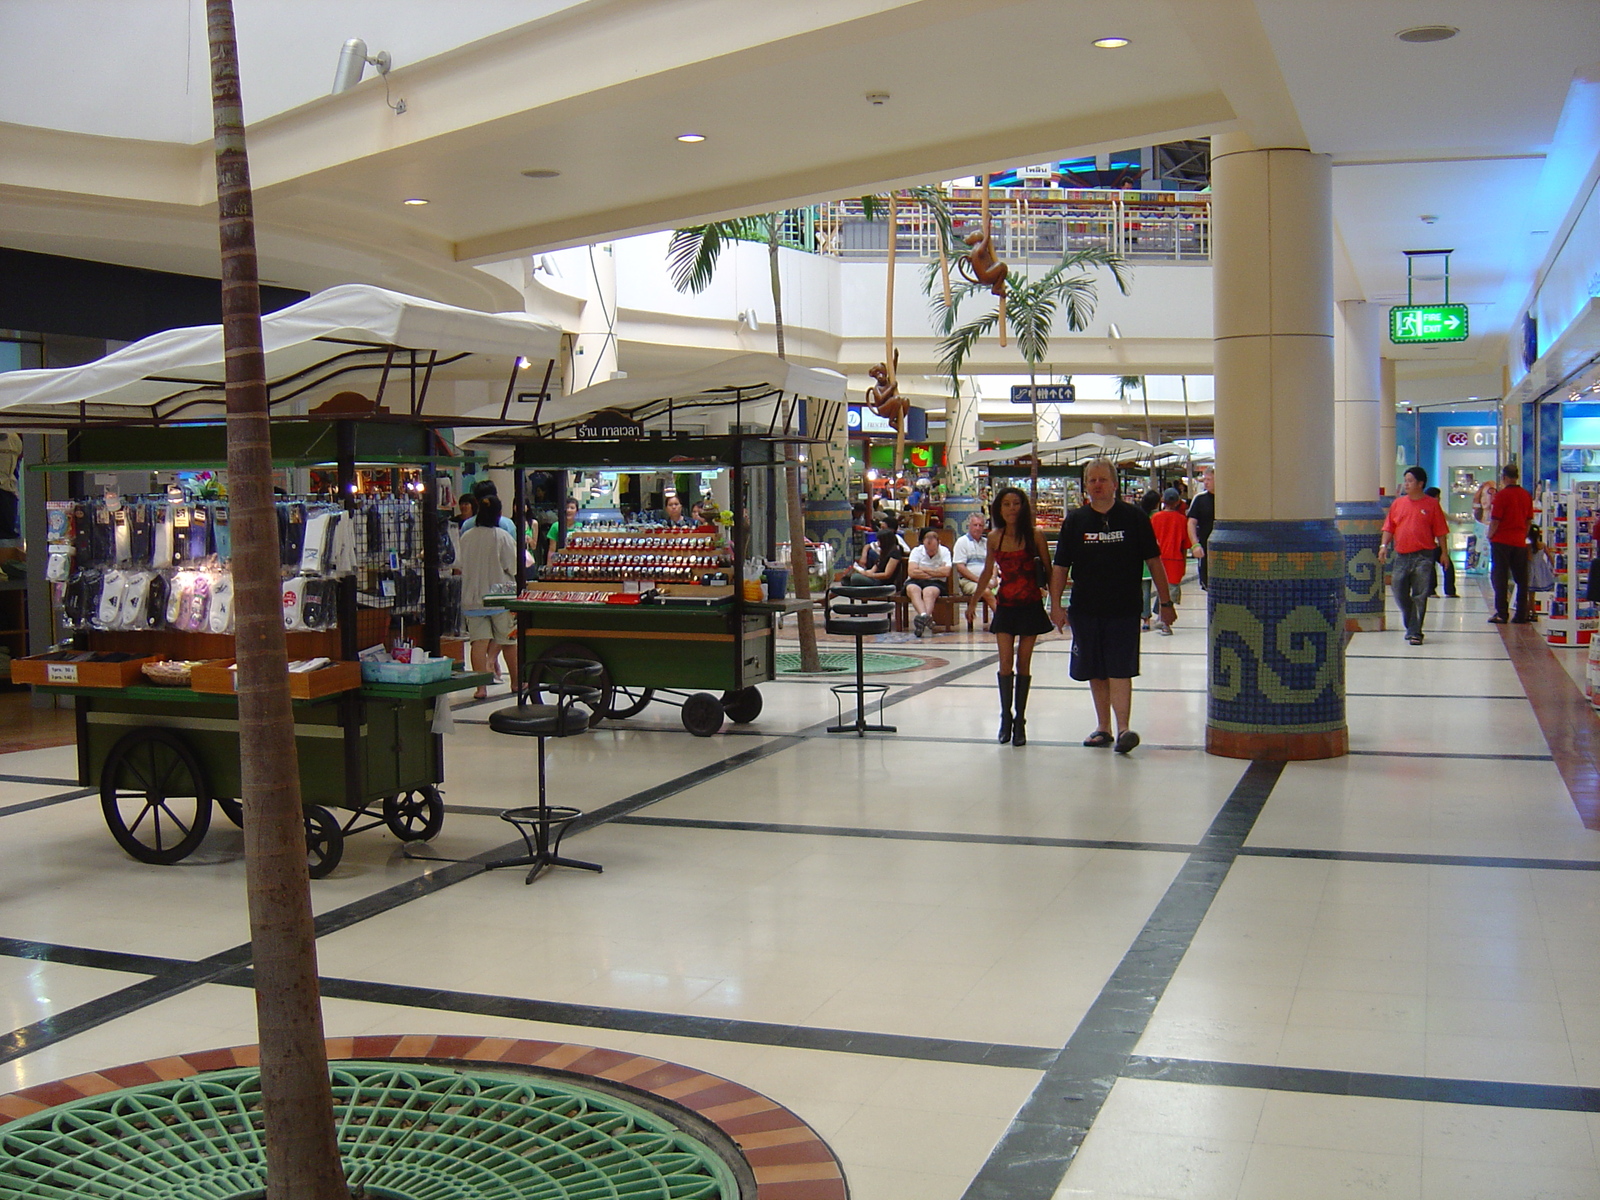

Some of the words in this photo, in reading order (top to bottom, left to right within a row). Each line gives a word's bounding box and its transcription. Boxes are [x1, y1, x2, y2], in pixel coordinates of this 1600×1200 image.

[1423, 313, 1442, 321] FIRE
[1423, 325, 1442, 333] EXIT
[579, 424, 597, 436] ร้าน
[601, 426, 640, 437] กาลเวลา
[1474, 433, 1498, 446] CIT
[1098, 531, 1124, 541] DIESEL
